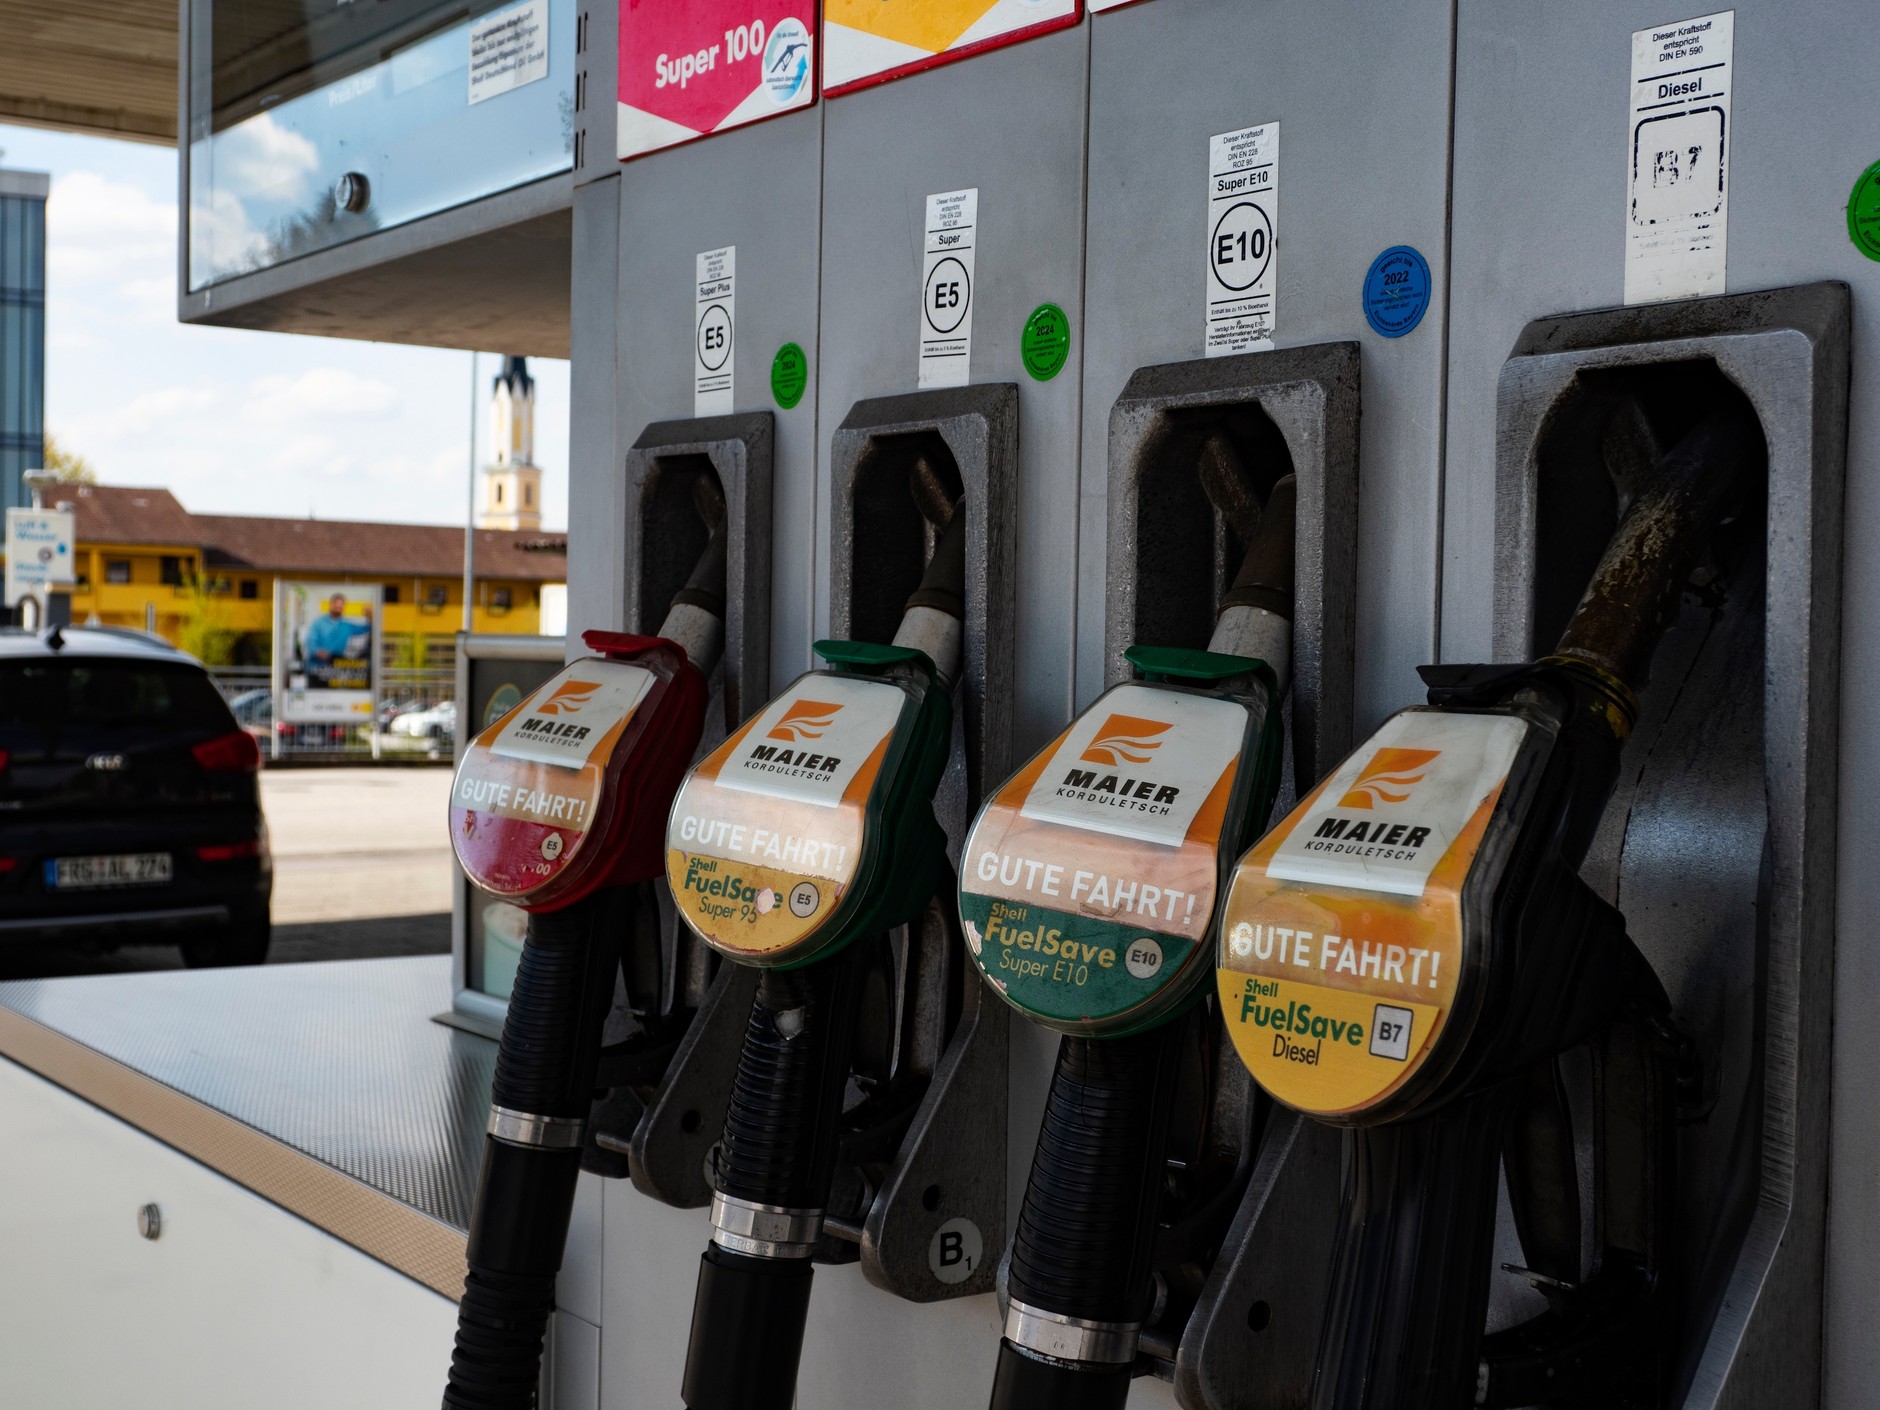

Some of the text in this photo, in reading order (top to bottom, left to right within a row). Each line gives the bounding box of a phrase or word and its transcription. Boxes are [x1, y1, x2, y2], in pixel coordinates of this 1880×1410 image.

[1652, 21, 1712, 42] Dieser Kraftstoff
[655, 19, 765, 89] Super 100
[1660, 46, 1704, 62] DIN EN 590
[1664, 36, 1700, 50] entspricht
[1658, 77, 1702, 99] Diesel
[1223, 128, 1264, 144] Dieser Kraftstoff
[1230, 140, 1256, 152] entspricht
[1232, 160, 1244, 168] ROZ
[1238, 150, 1247, 158] EN
[1218, 170, 1268, 192] Super E10
[938, 234, 960, 246] Super
[1218, 228, 1265, 265] E10
[1384, 270, 1409, 286] 2022
[700, 283, 730, 296] Super Plus
[935, 282, 959, 309] E5
[705, 326, 724, 350] E5
[1036, 324, 1054, 336] 2024
[514, 731, 581, 748] KORDULETSCH
[520, 718, 592, 740] MAIER
[750, 744, 841, 773] MAIER
[744, 761, 832, 782] KORDULETSCH
[1062, 768, 1180, 805] MAIER
[460, 778, 586, 822] GUTE FAHRT!
[1056, 787, 1170, 816] KORDULETSCH
[680, 816, 847, 872] GUTE FAHRT!
[1314, 817, 1432, 849] MAIER
[546, 840, 558, 851] E5
[1304, 840, 1416, 862] KORDULETSCH
[689, 857, 717, 873] Shell
[684, 868, 783, 910] FuelSae
[977, 850, 1196, 926] GUTE FAHRT!
[698, 895, 758, 923] Super 95
[796, 893, 812, 906] E5
[991, 902, 1027, 920] Shell
[984, 917, 1116, 968] FuelSave
[1130, 950, 1157, 966] E10
[1233, 922, 1441, 989] GUTE FAHRT!
[1000, 949, 1089, 986] Super E10
[1245, 978, 1278, 998] Shell
[1240, 994, 1364, 1046] FuelSave
[1378, 1020, 1404, 1044] B7
[1272, 1033, 1321, 1066] Diesel
